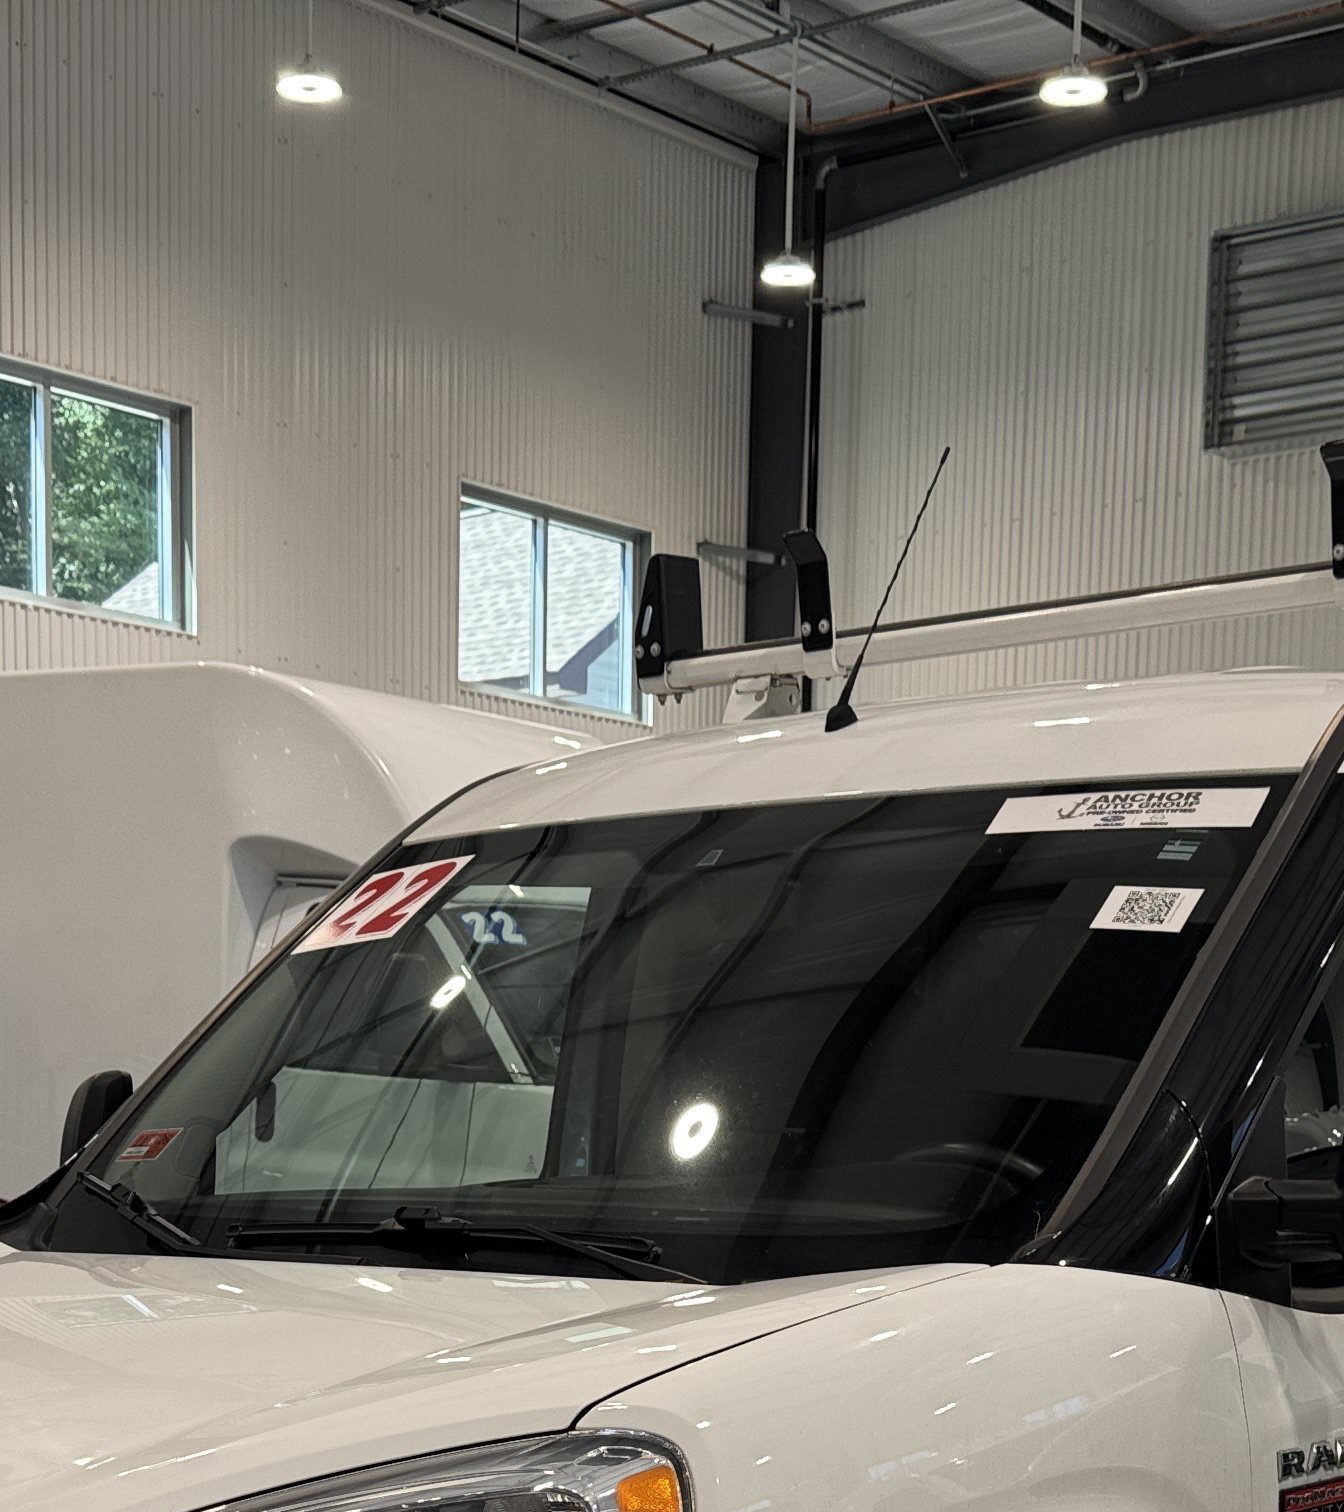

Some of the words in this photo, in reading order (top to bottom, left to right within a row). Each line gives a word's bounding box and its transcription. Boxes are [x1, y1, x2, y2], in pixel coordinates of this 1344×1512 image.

[1086, 802, 1134, 811] AUTO
[1138, 800, 1201, 809] GROUP
[1093, 792, 1203, 804] ANCHOR
[308, 861, 458, 945] 22
[461, 910, 528, 945] 22
